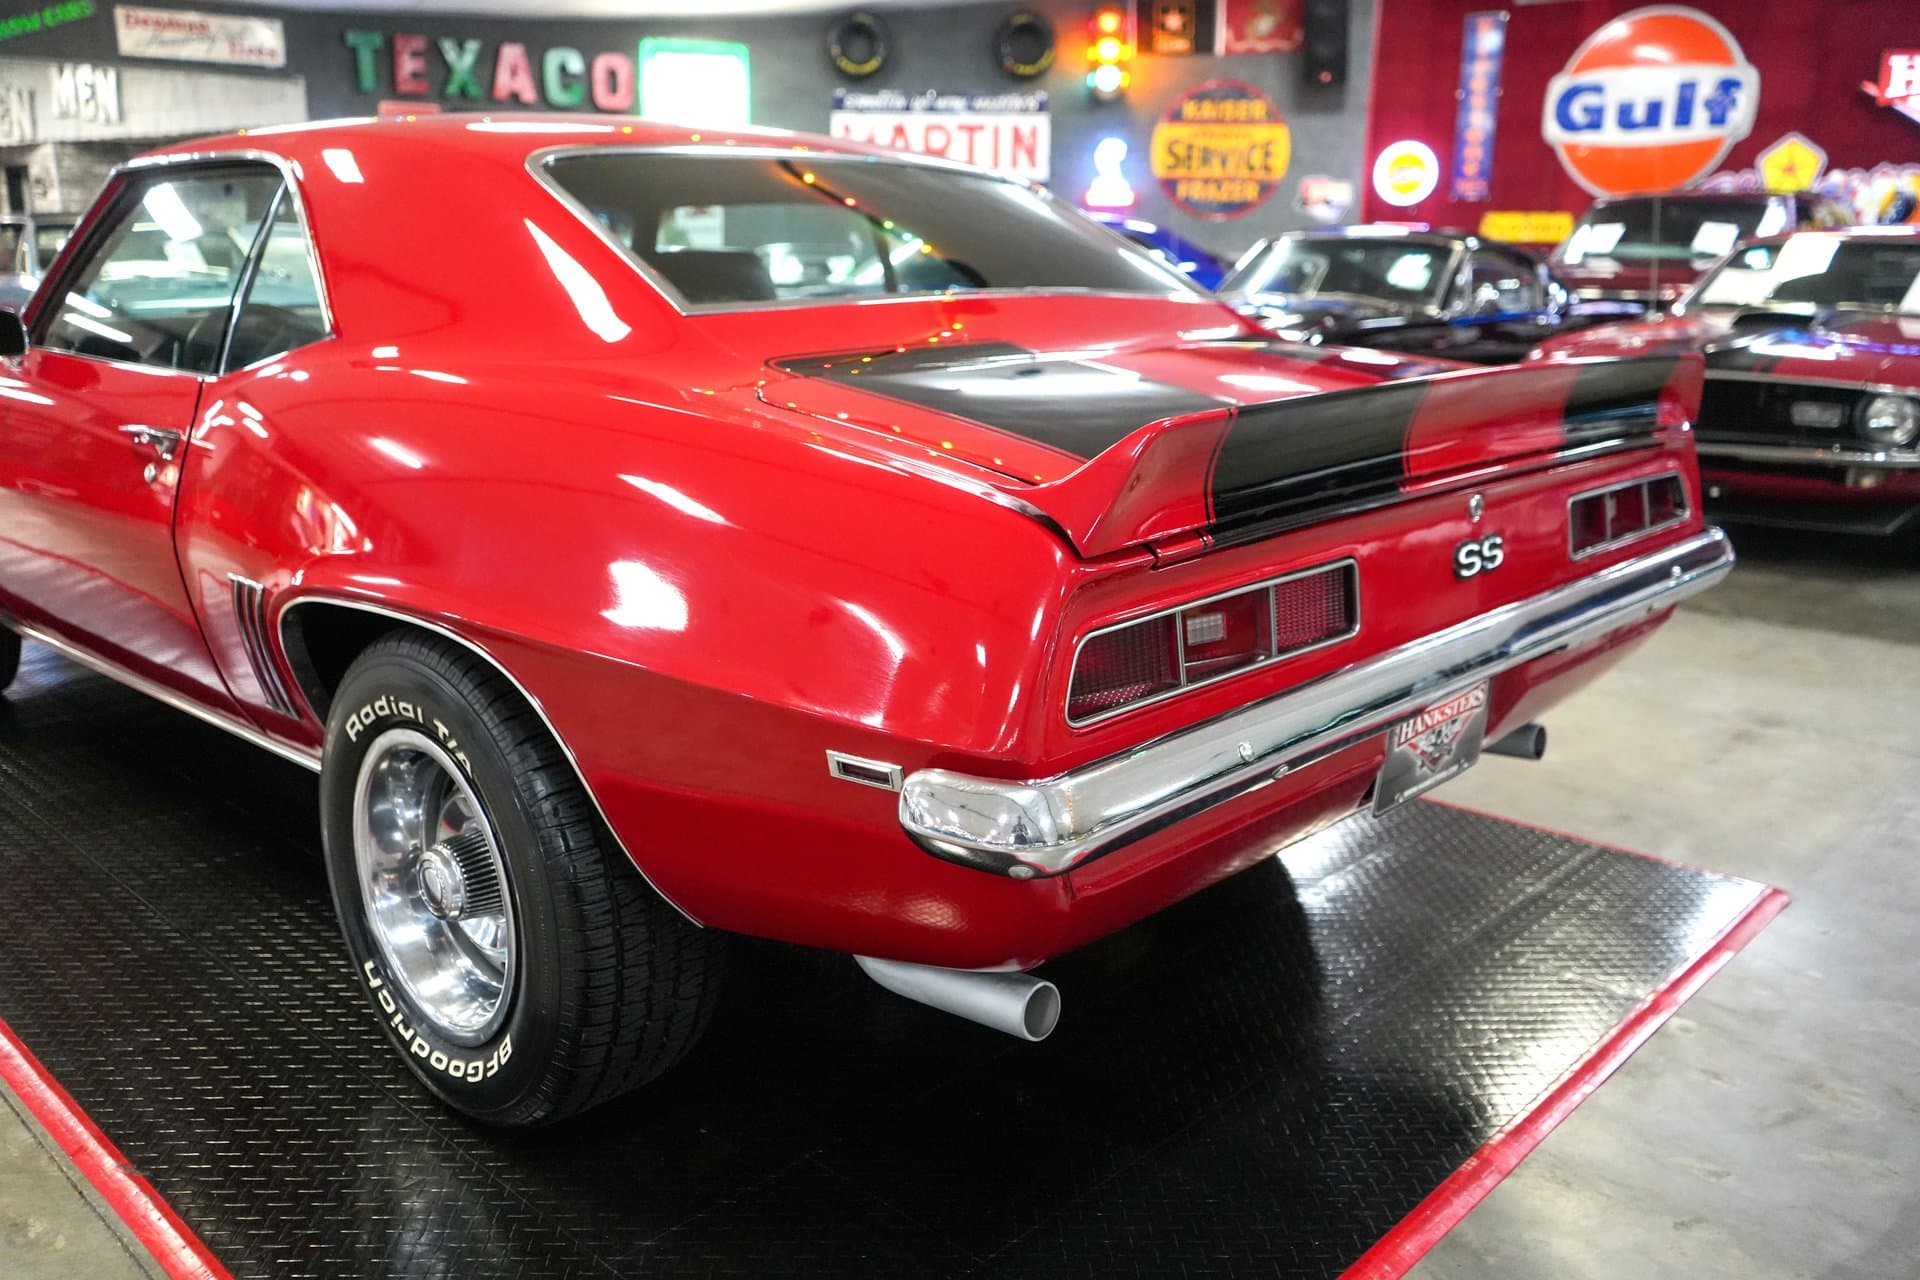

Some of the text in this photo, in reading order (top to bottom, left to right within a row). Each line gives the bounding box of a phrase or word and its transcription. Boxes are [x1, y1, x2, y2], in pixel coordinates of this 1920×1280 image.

[50, 62, 122, 126] MEN
[344, 29, 634, 111] TEXACO
[1182, 98, 1268, 120] KAISER
[1556, 78, 1742, 132] Gulf
[1166, 139, 1273, 174] SERVICE
[1176, 179, 1260, 203] FRAZER
[1456, 534, 1505, 579] SS
[345, 694, 424, 742] Radial
[364, 960, 513, 1083] BFGoodrich
